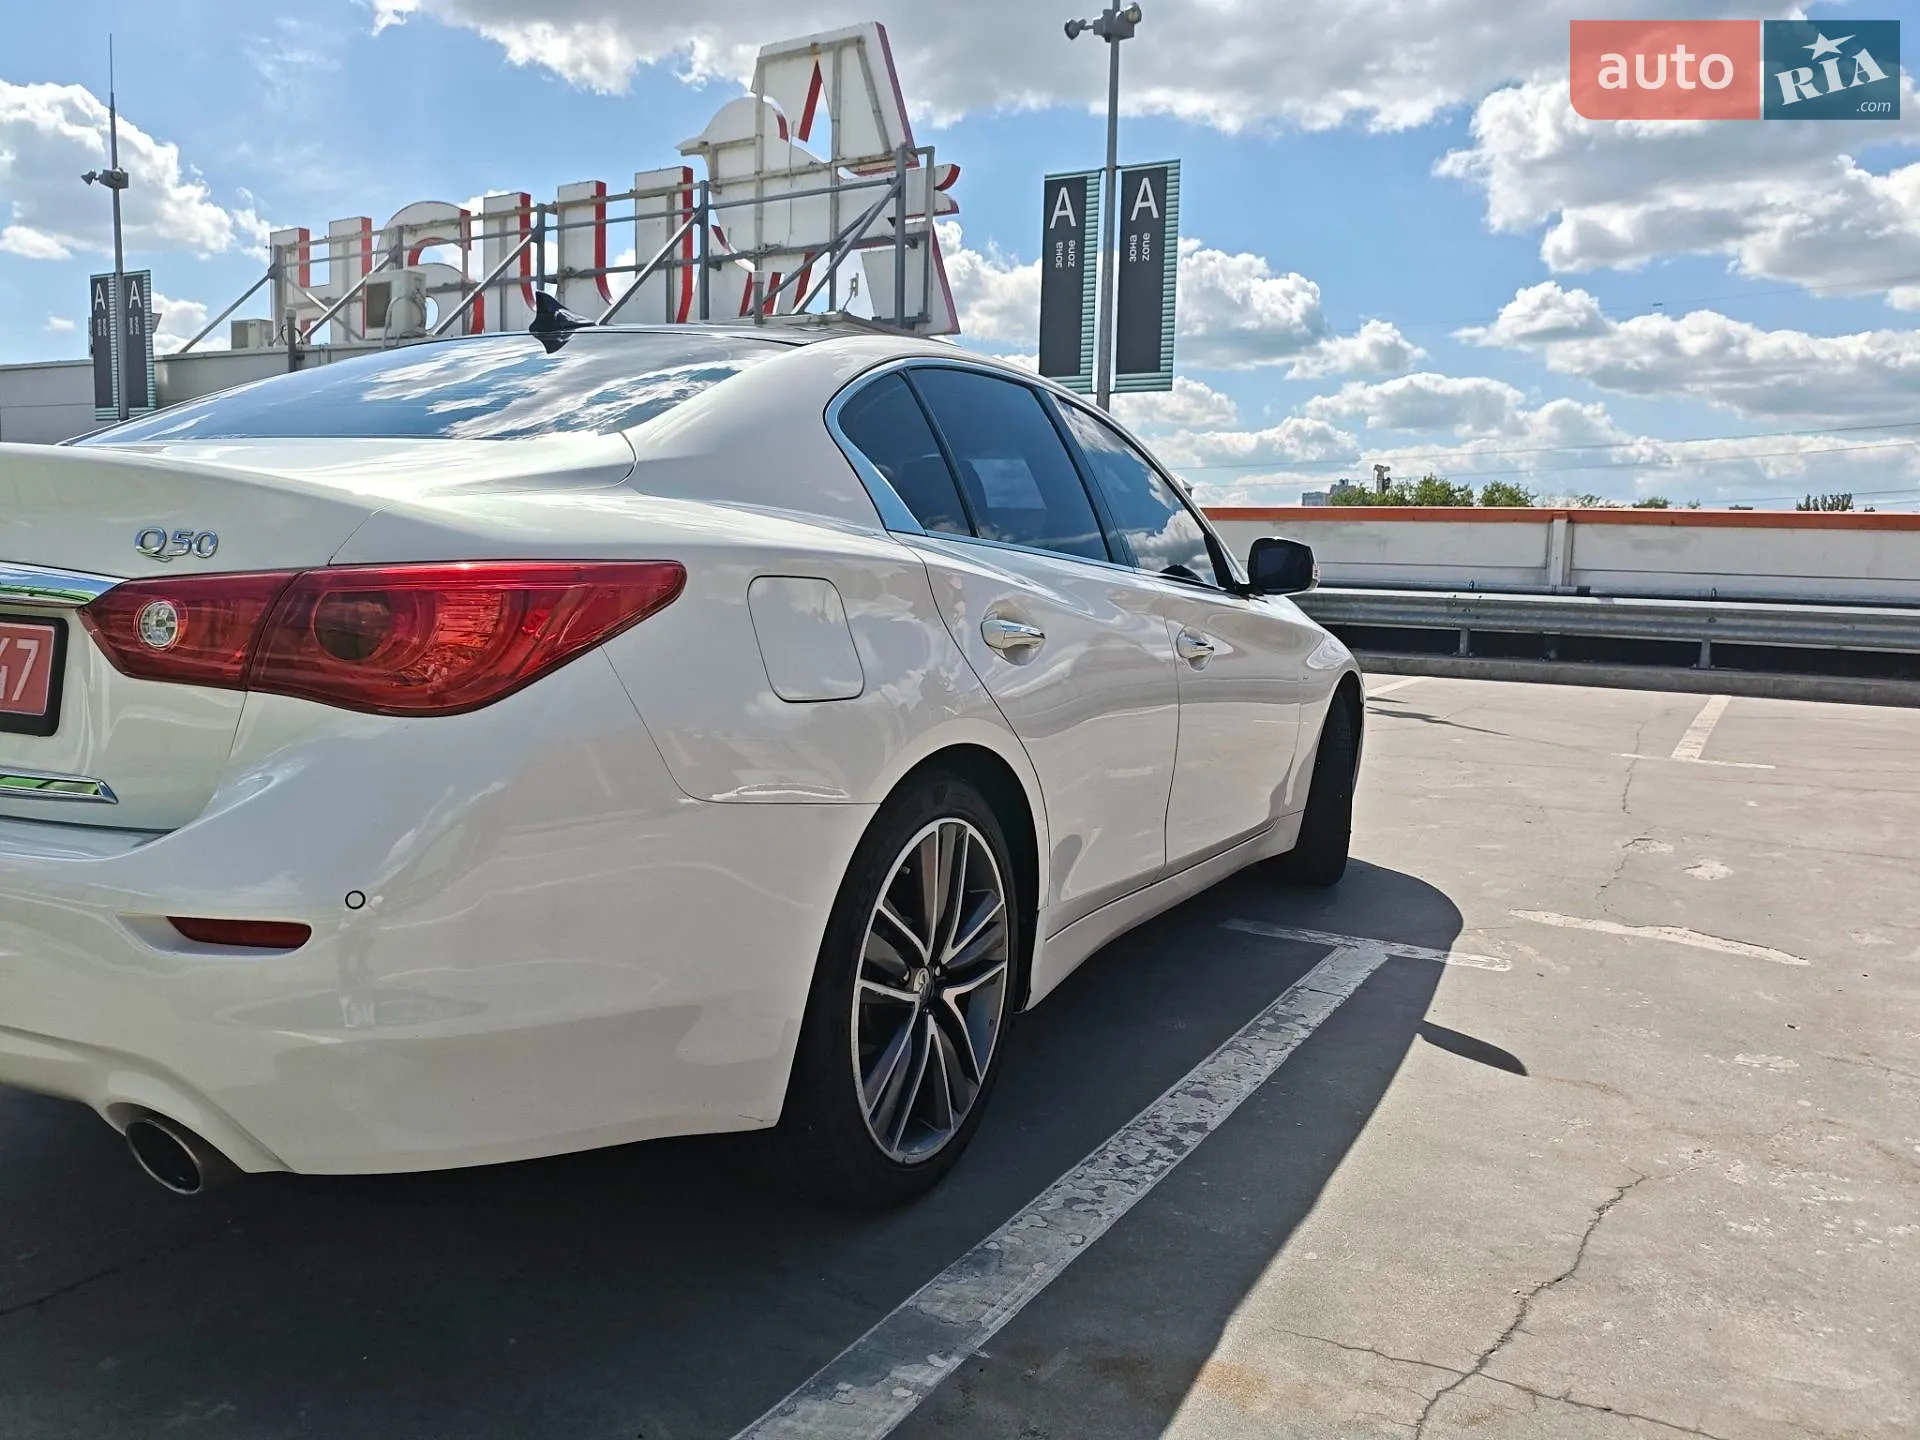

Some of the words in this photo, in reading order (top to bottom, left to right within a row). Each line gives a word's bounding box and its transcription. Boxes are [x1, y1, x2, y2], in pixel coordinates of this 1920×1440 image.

[1049, 186, 1077, 230] A
[1130, 176, 1160, 222] A
[1055, 241, 1064, 269] зона
[1067, 239, 1076, 268] zone
[1128, 234, 1138, 263] зона
[1141, 232, 1151, 262] zone
[134, 526, 219, 562] Q50
